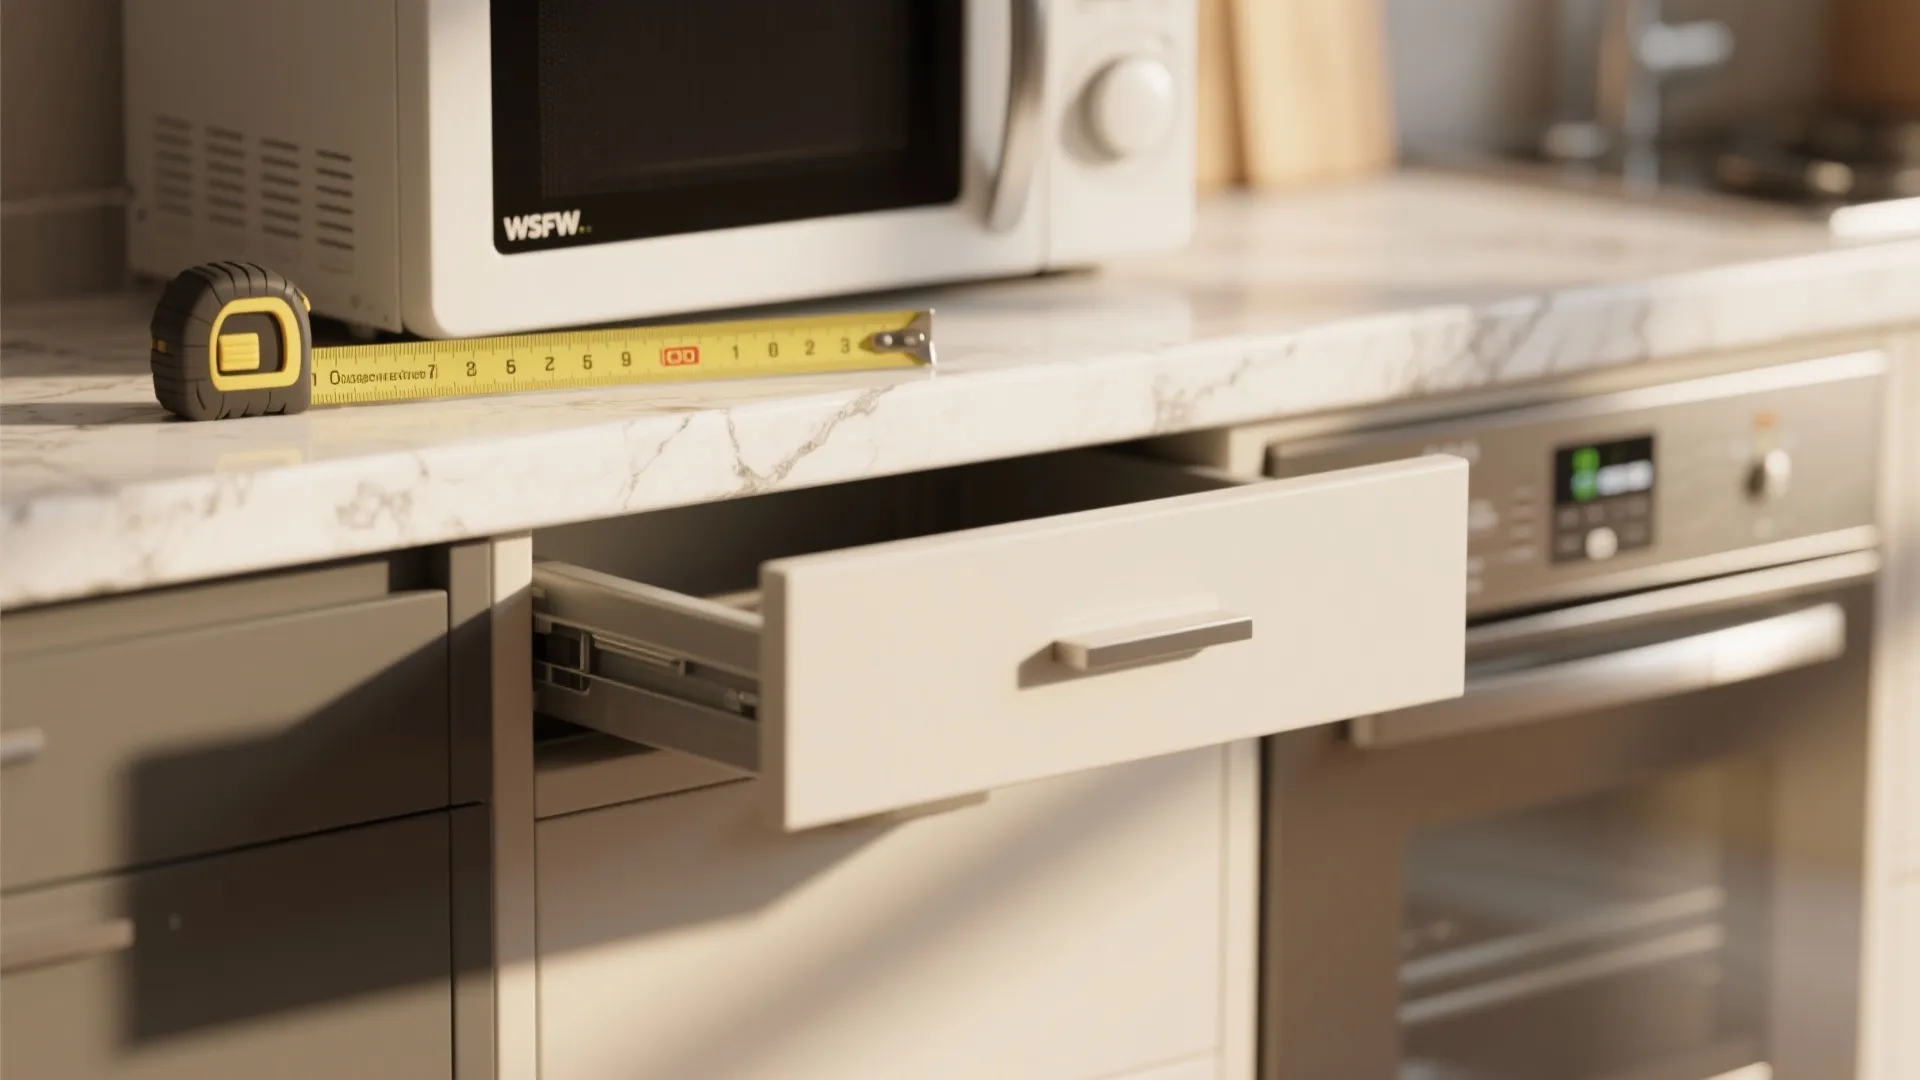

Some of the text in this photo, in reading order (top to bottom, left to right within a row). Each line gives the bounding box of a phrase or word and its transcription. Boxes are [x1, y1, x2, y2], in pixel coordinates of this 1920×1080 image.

[545, 356, 555, 372] 2
[621, 351, 632, 367] 9
[732, 344, 739, 360] 1
[804, 340, 815, 356] 2
[840, 337, 850, 354] 3
